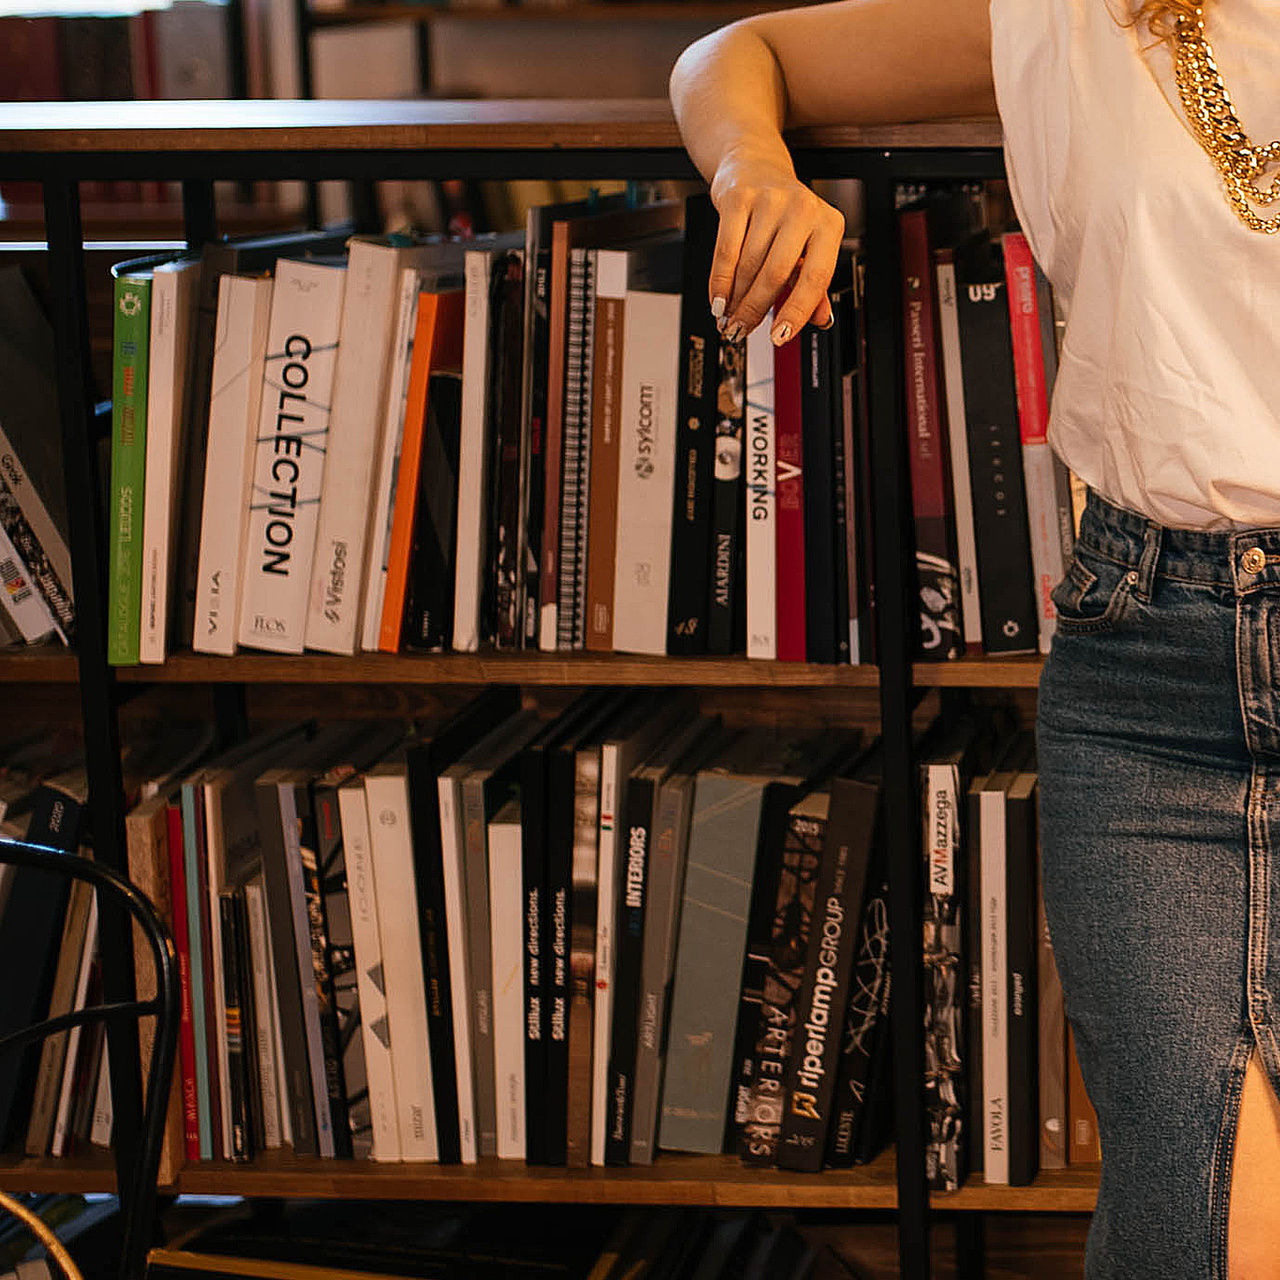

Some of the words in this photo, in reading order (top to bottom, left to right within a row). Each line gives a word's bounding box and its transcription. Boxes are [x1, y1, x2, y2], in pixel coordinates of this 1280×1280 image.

[635, 385, 656, 455] sylcom
[913, 351, 931, 438] International
[261, 333, 313, 576] COLLECTION
[752, 415, 769, 521] WORKING
[326, 541, 347, 608] Vistosi
[625, 826, 647, 908] INTERIORS
[932, 789, 951, 888] AVMazzega
[527, 887, 540, 956] directions.
[551, 887, 565, 956] directions.
[529, 957, 540, 986] new
[553, 957, 564, 986] new
[527, 997, 542, 1041] Stillux
[551, 997, 565, 1041] Stillux
[746, 1008, 787, 1157] ARTERIORS
[989, 1097, 1005, 1153] FAVOLA
